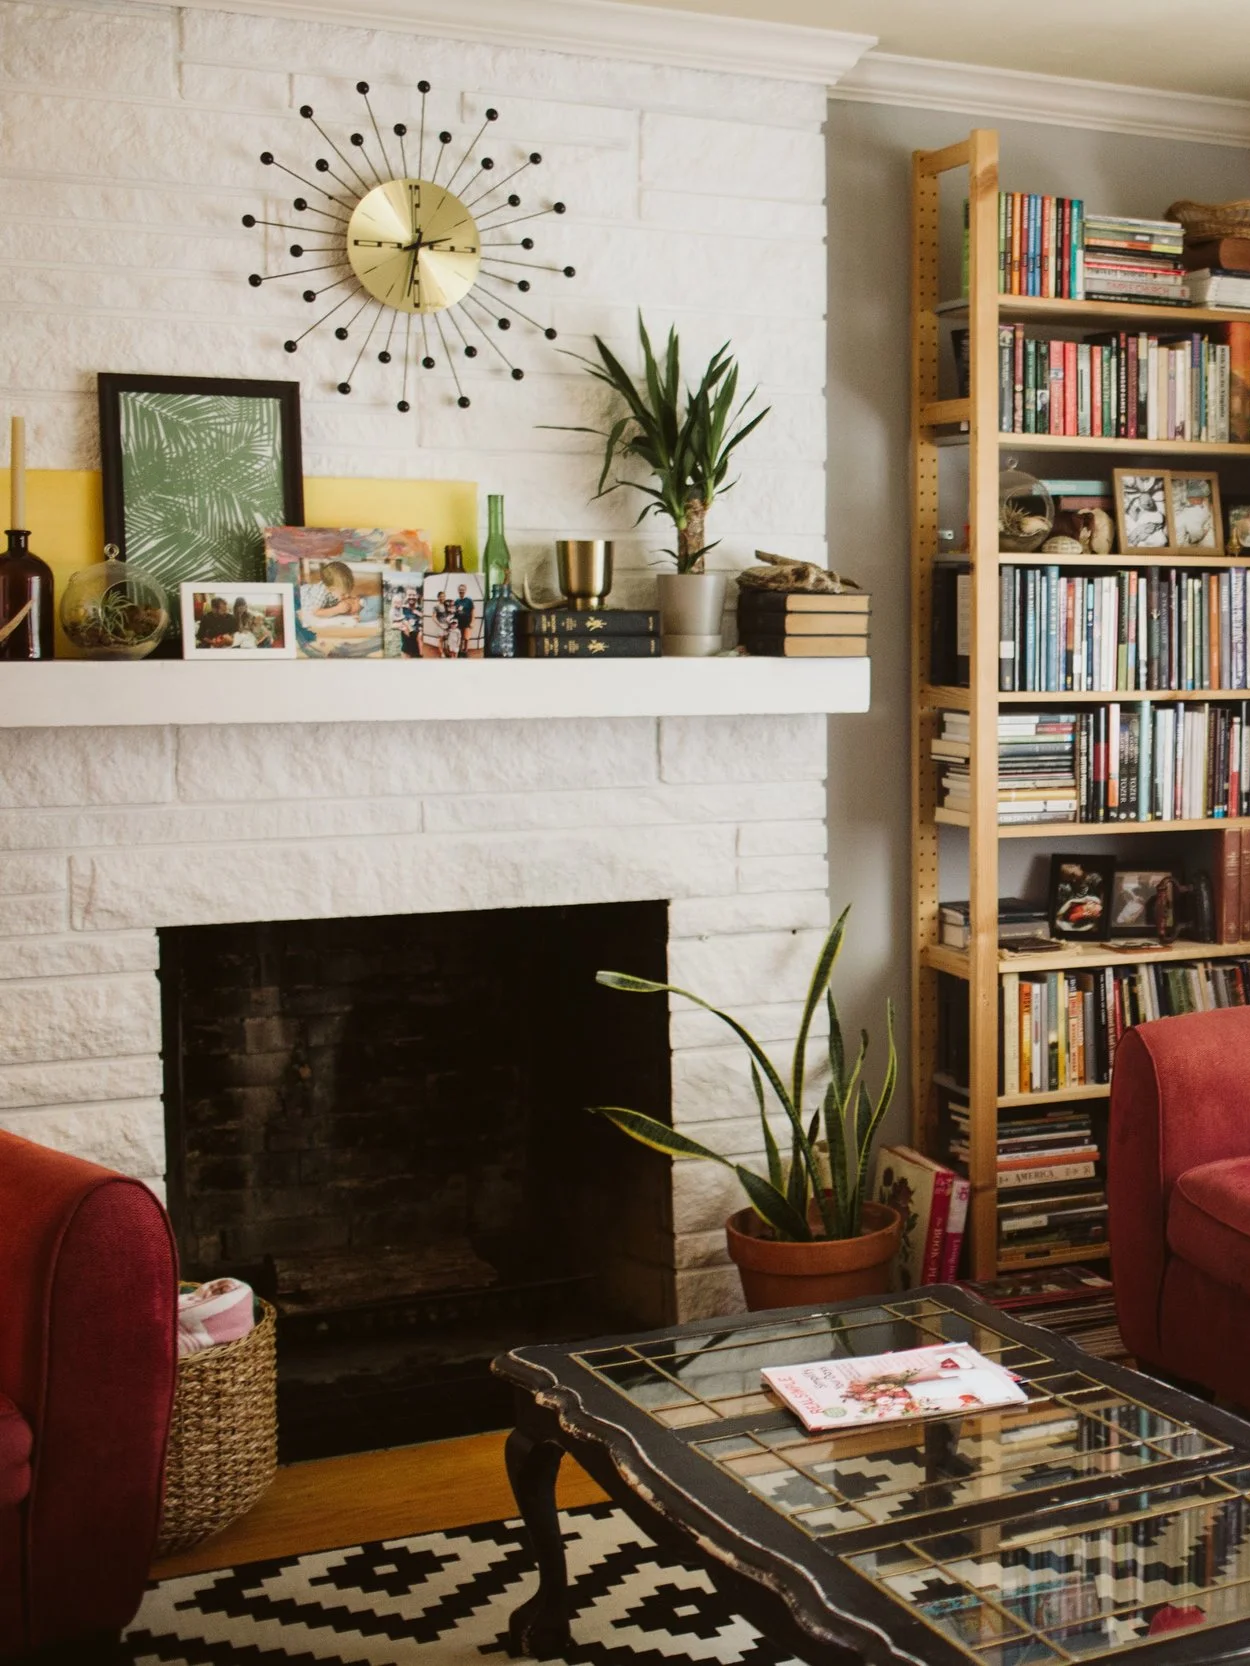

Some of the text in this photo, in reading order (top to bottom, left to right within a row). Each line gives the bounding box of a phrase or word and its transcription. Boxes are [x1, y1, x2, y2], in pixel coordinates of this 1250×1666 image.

[1015, 1170, 1054, 1182] AMERICA
[931, 1228, 943, 1258] BOOK
[776, 1376, 824, 1415] REAL SIMPLE
